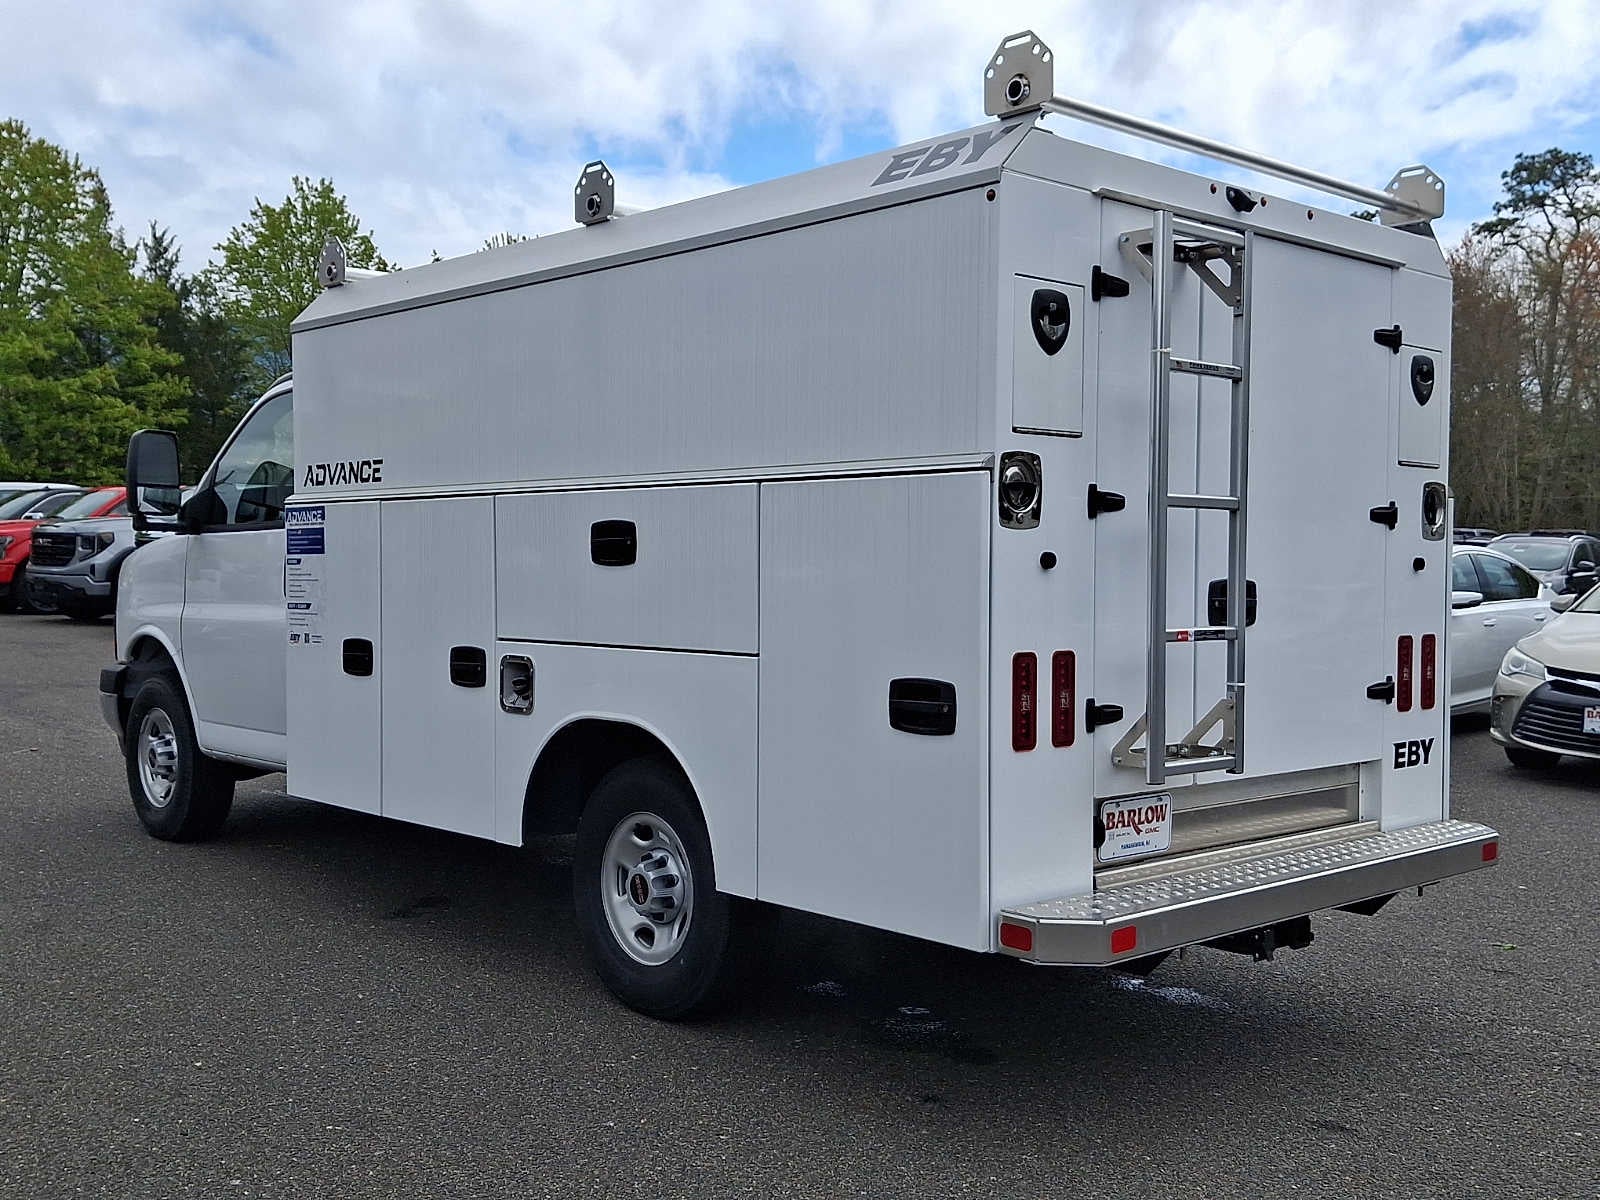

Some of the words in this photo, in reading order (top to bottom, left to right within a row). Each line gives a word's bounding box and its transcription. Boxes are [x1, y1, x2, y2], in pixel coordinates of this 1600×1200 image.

[870, 122, 1023, 187] EBY
[304, 458, 384, 487] ADVANCE
[287, 510, 322, 523] ADVANCE
[1393, 738, 1435, 769] EBY
[1105, 804, 1168, 835] BARLOW
[1145, 826, 1160, 835] GMC
